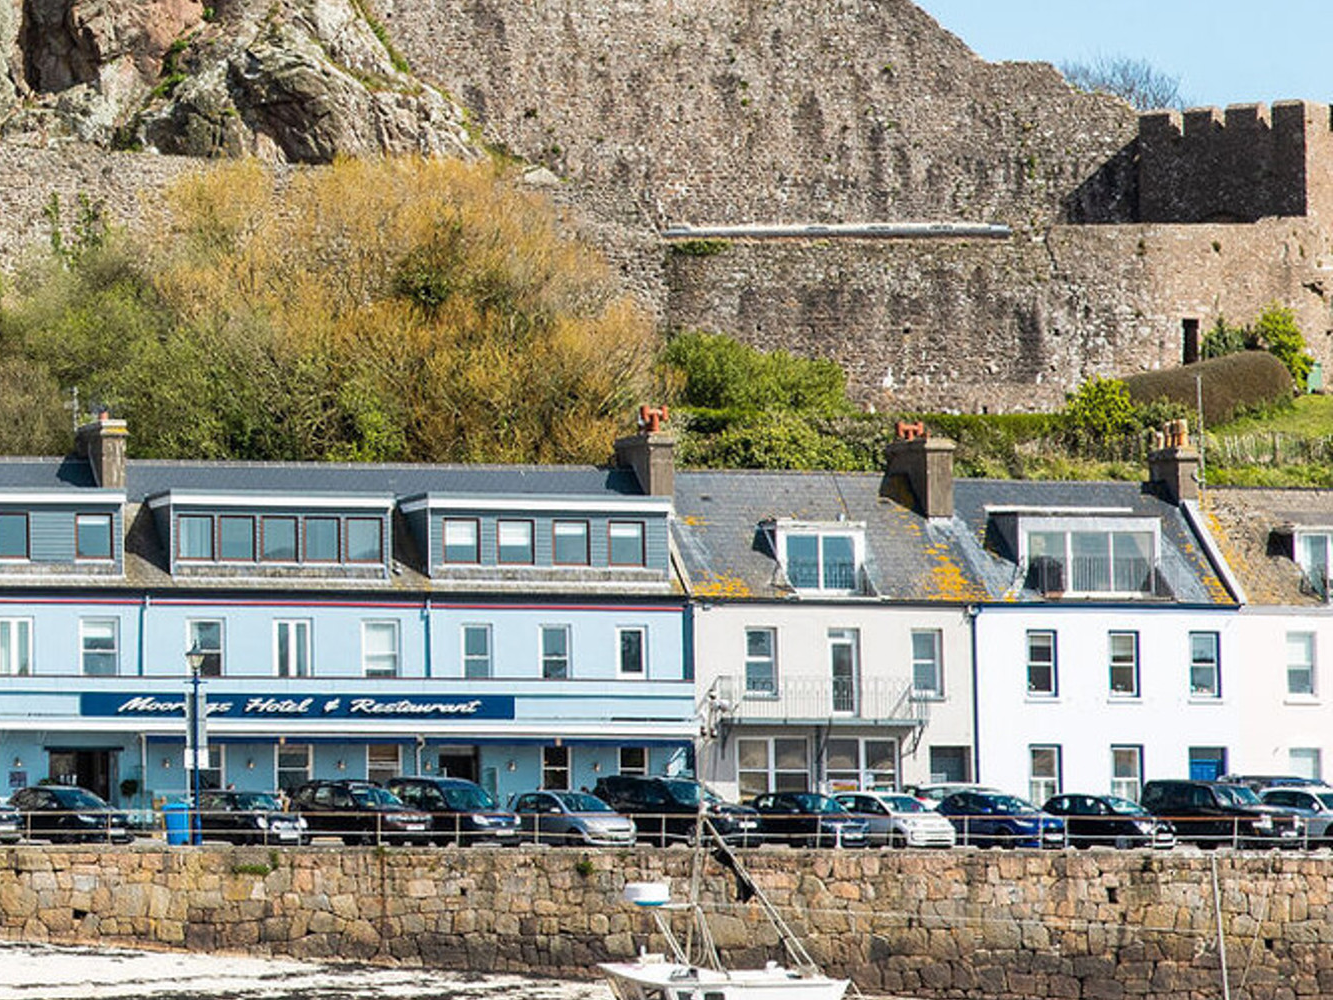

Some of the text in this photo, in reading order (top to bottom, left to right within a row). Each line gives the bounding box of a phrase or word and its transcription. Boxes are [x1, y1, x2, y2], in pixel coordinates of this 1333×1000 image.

[118, 697, 482, 715] Moorgs Hotel & Restaurant
